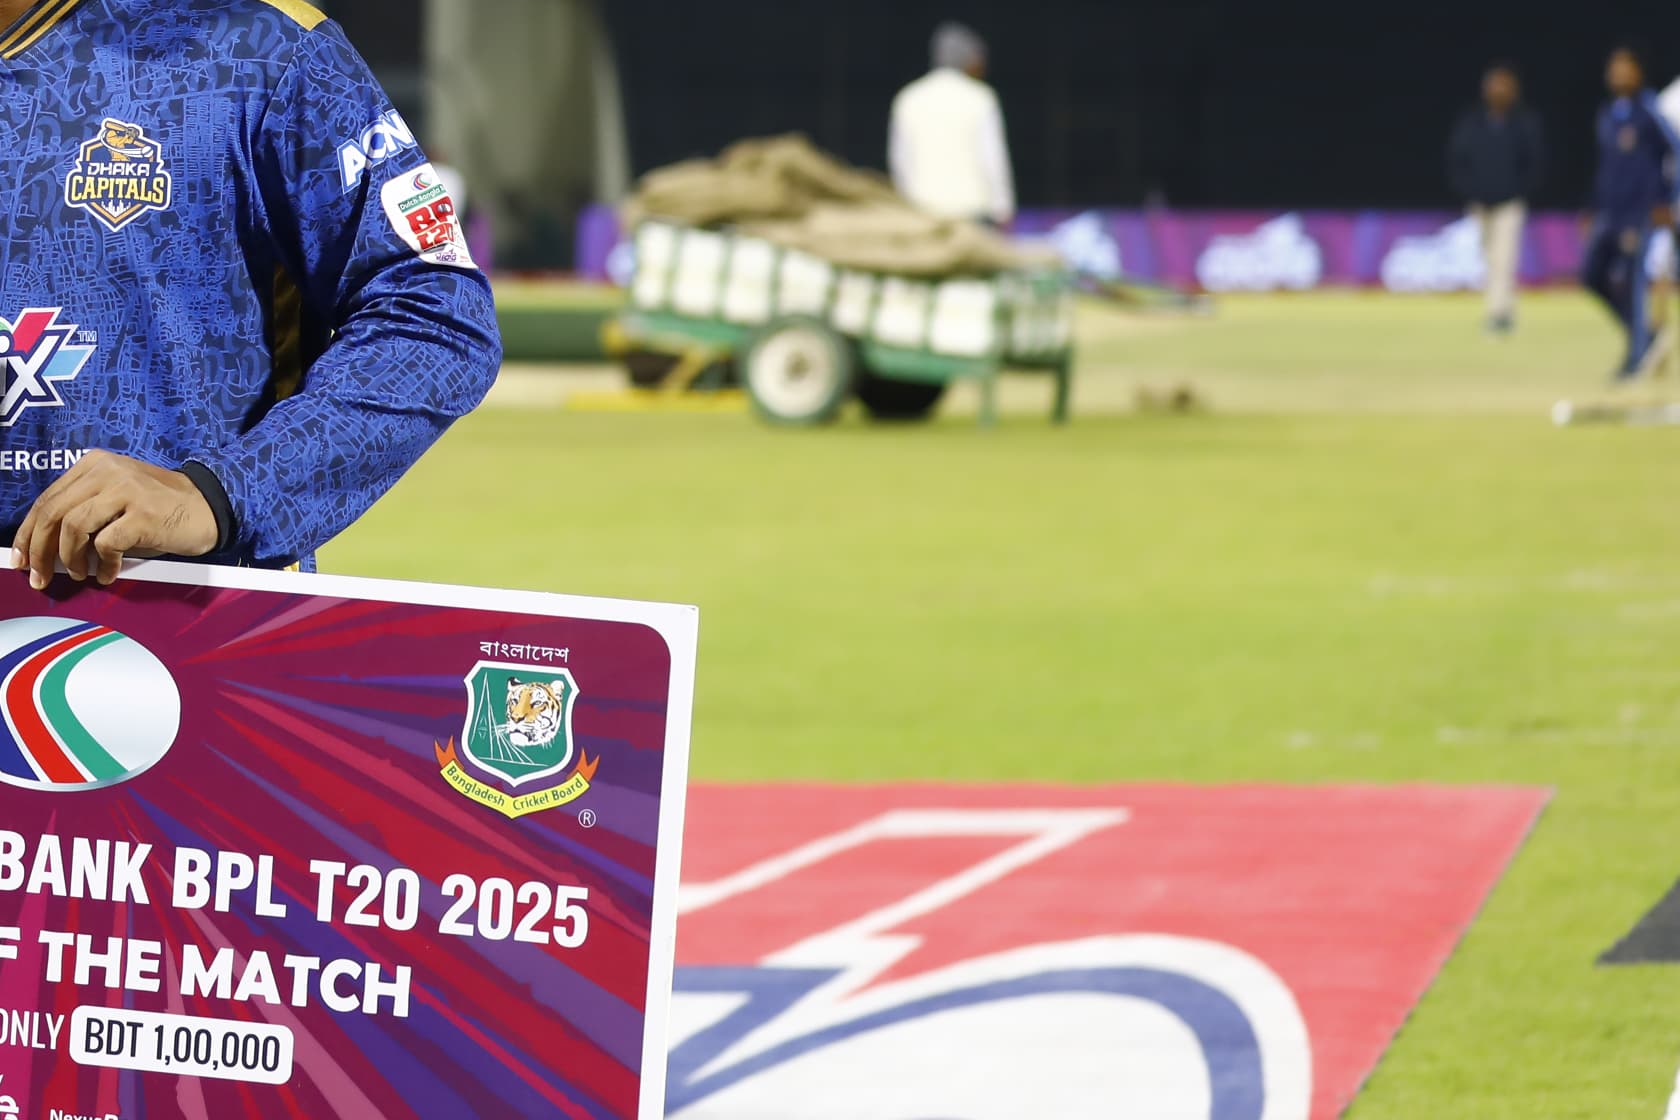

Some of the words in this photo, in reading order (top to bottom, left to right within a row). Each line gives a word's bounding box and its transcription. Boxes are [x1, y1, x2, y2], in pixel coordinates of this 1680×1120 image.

[71, 175, 164, 204] CAPITALS
[86, 161, 151, 177] DHAKA
[405, 196, 457, 234] BP
[479, 640, 571, 663] বাংলাদেশ
[446, 765, 505, 807] Bangladesh
[512, 791, 549, 811] Cricket
[552, 777, 584, 801] Board
[172, 846, 288, 919] BPL
[309, 860, 420, 931] T20
[438, 873, 589, 949] 2025
[38, 930, 161, 989] THE
[180, 943, 412, 1019] MATCH
[84, 1017, 143, 1058] BDT
[154, 1024, 280, 1072] 1,00,000
